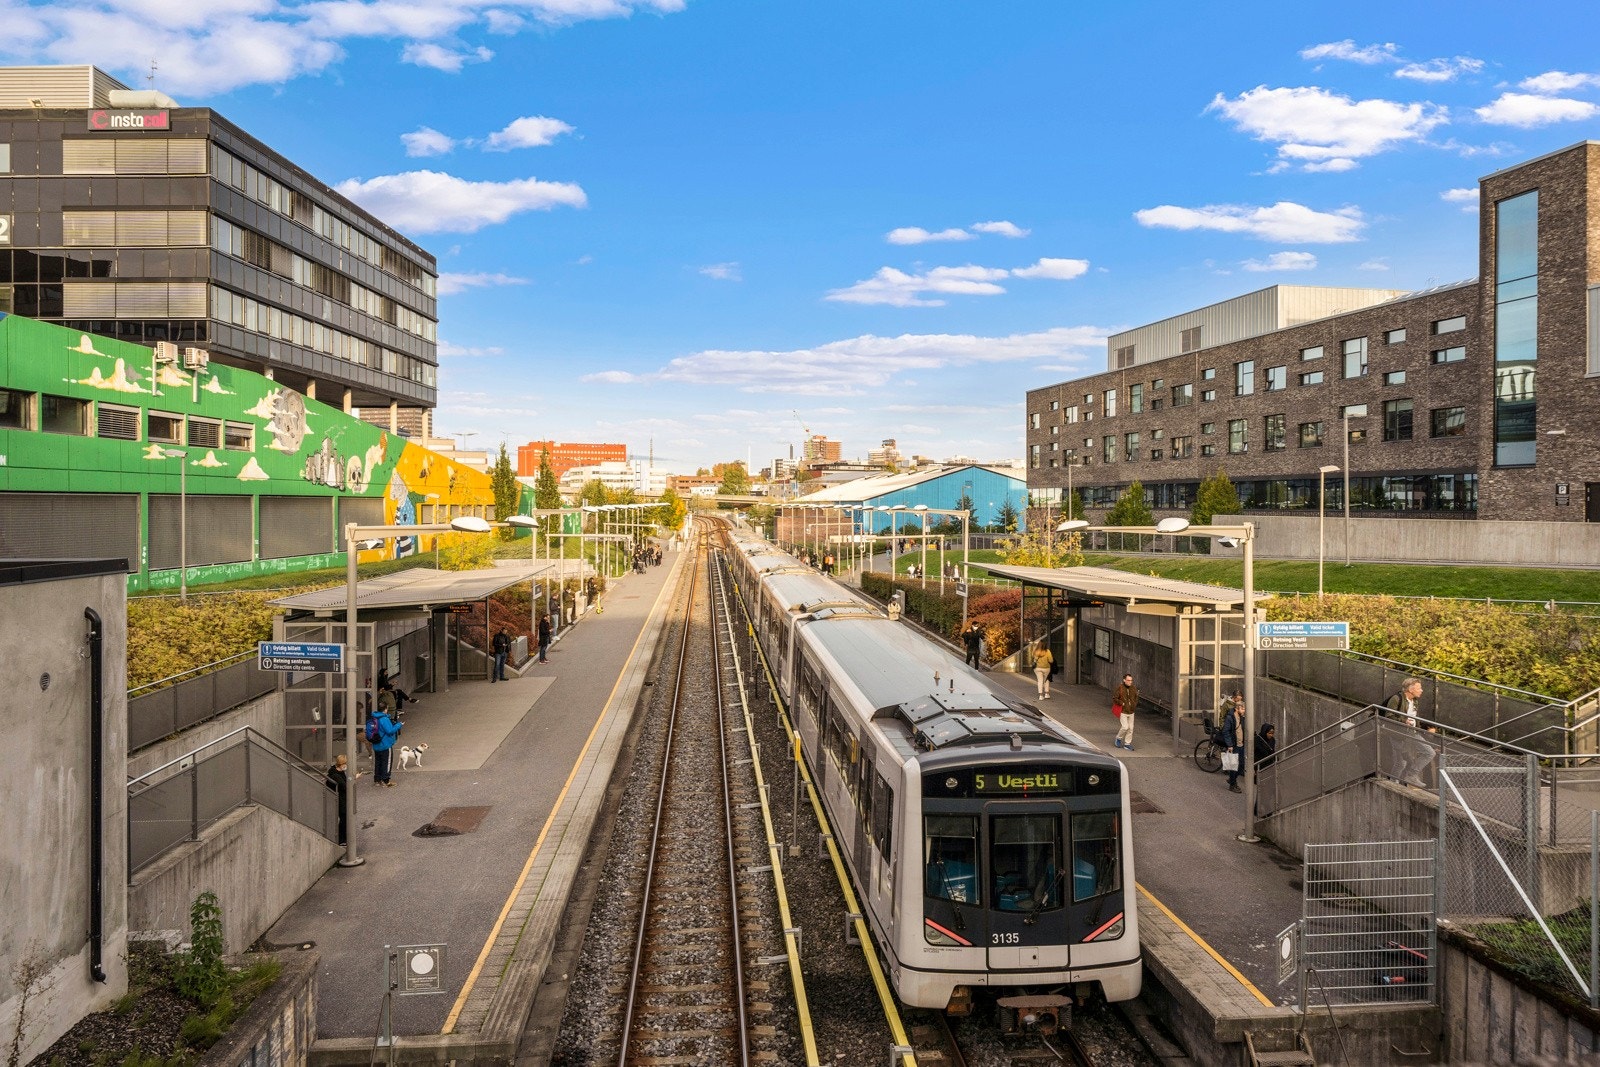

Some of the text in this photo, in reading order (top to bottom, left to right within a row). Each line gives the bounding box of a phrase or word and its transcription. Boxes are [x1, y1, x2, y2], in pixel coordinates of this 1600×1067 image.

[110, 111, 167, 128] instacall
[975, 774, 1058, 789] 5 Vestli
[992, 932, 1020, 944] 3135
